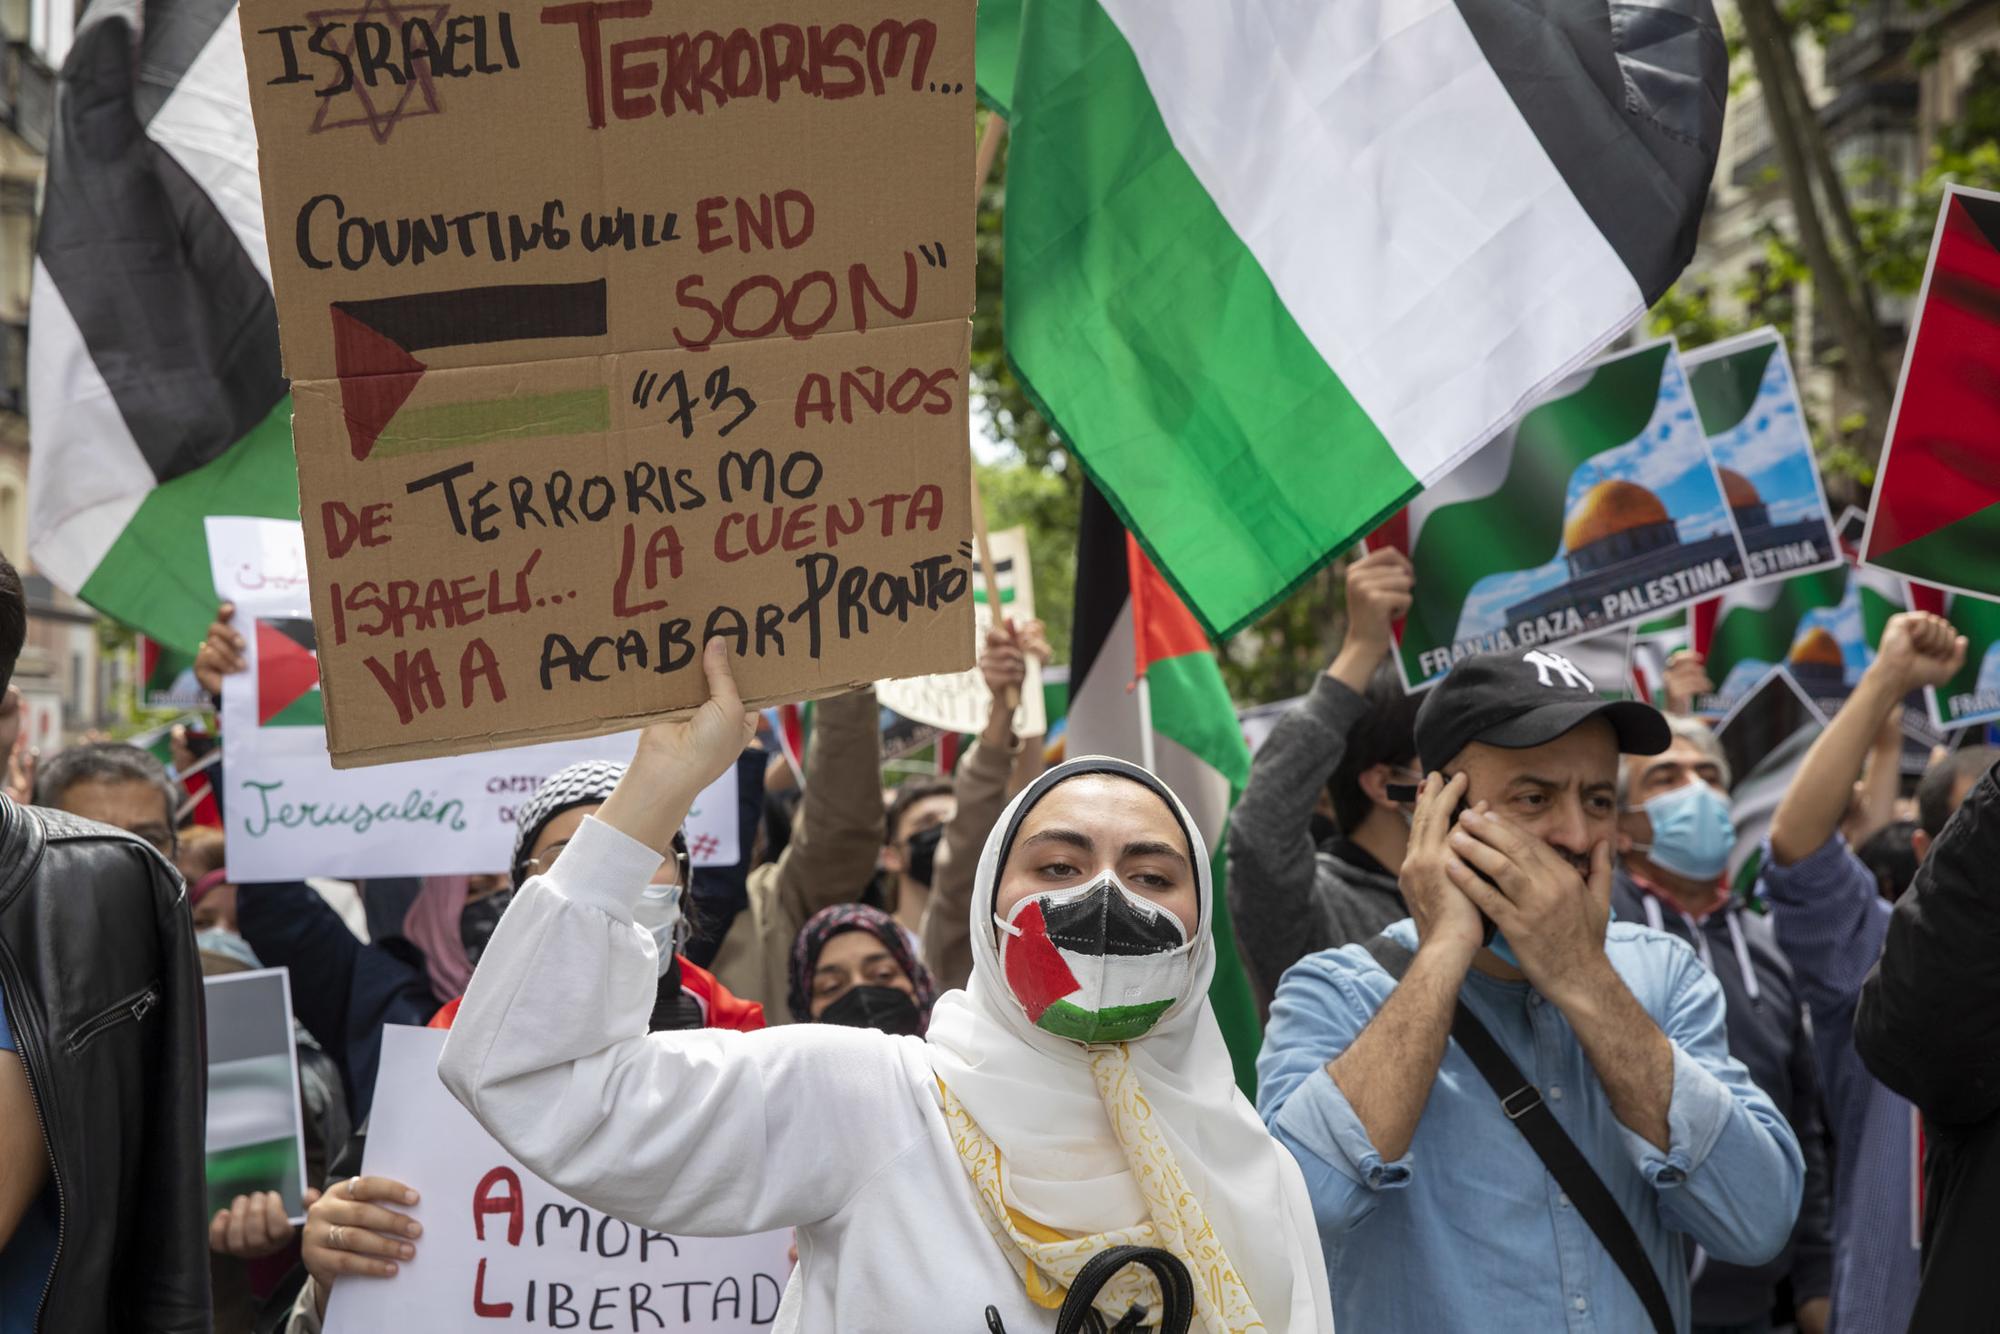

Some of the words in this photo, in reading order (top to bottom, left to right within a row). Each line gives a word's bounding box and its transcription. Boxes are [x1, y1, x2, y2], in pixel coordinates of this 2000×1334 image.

[258, 13, 521, 97] ISRAELI
[541, 0, 964, 130] TERRORISM...
[296, 194, 570, 271] COUNTING
[696, 189, 815, 254] END
[795, 366, 959, 428] AÑOS
[322, 502, 393, 559] DE
[406, 448, 824, 543] TERRORISMO
[613, 523, 686, 617] LA
[714, 484, 944, 563] CUENTA
[1517, 606, 1585, 648] GAZA
[1601, 557, 1732, 620] PALESTINA
[362, 654, 446, 725] VA
[460, 637, 507, 708] A
[538, 605, 785, 690] ACABAR
[241, 779, 468, 839] Jerusalén
[473, 1165, 680, 1262] AMOR
[473, 1257, 781, 1333] LIBERTAD
